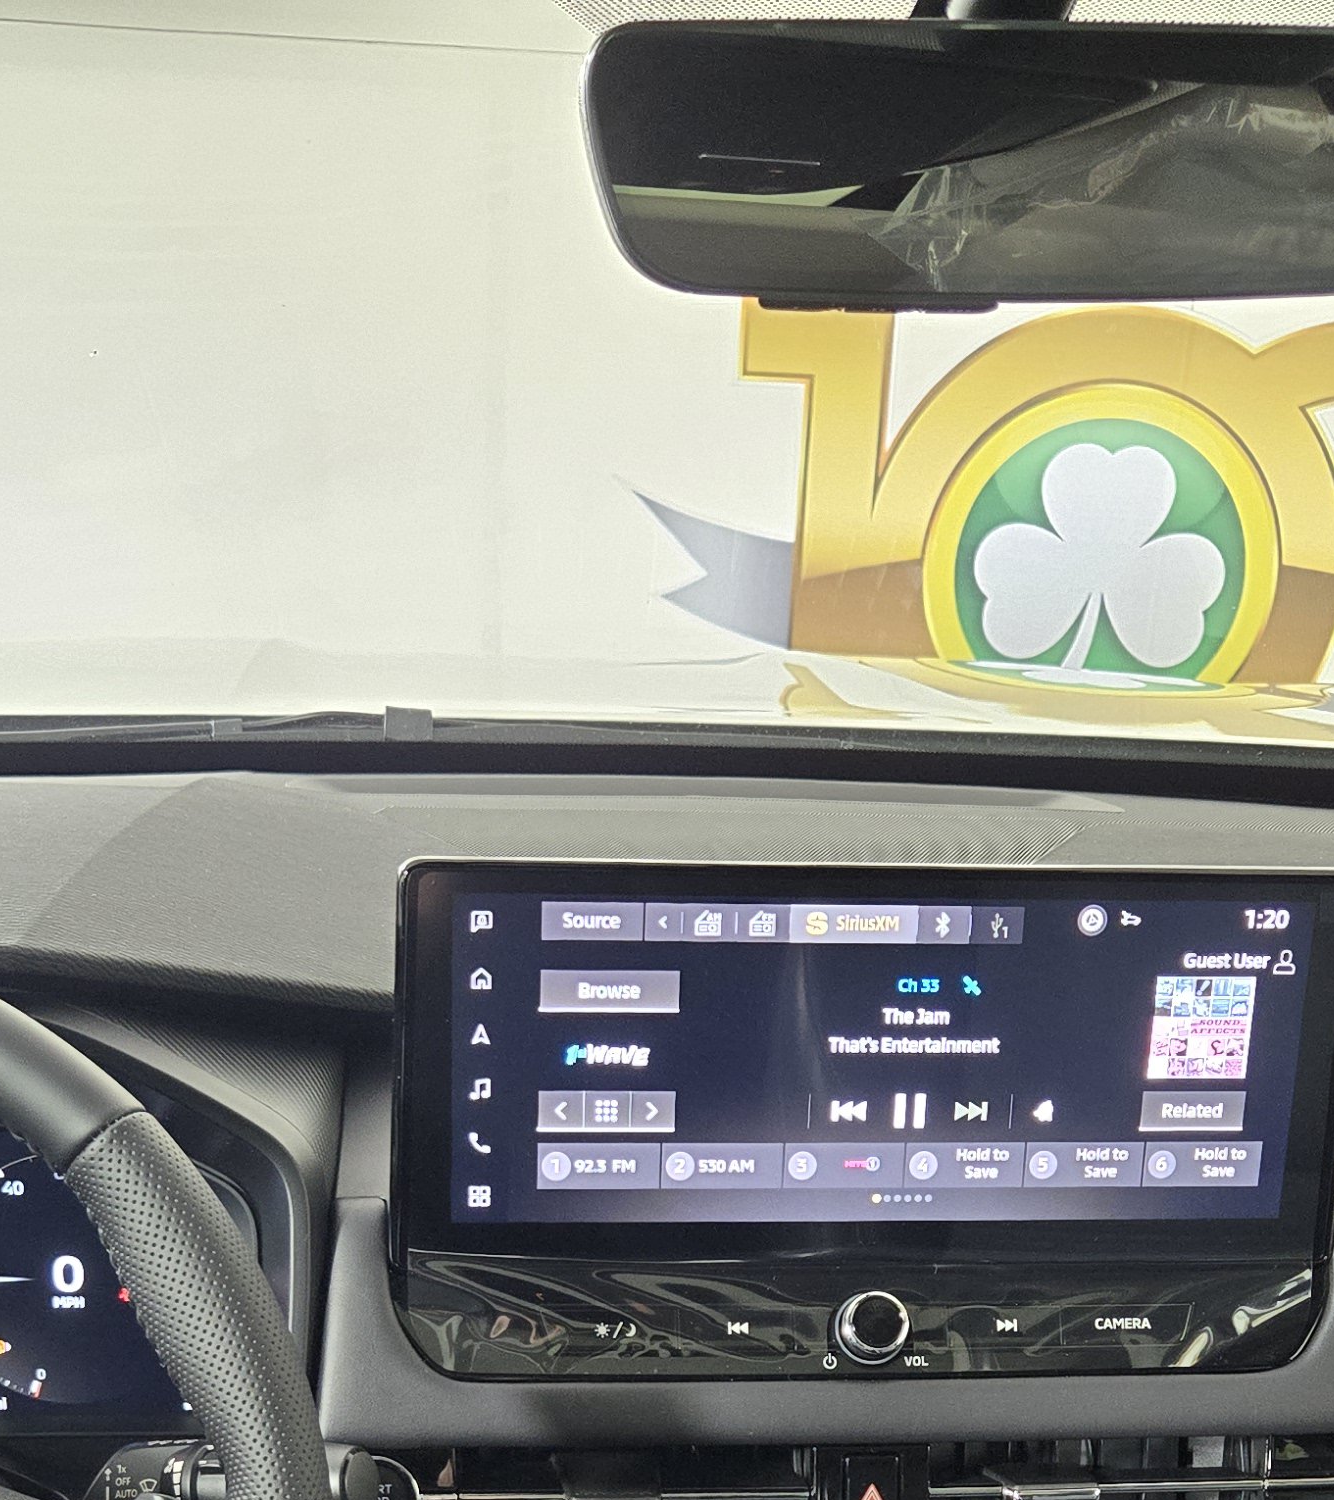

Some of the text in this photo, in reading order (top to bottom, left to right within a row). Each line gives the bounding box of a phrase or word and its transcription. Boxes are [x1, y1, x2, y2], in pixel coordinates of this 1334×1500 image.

[562, 912, 621, 930] Source
[836, 914, 900, 932] SiriusXM
[1244, 909, 1291, 929] 1:20
[1183, 952, 1271, 970] Guest User
[578, 982, 641, 1000] Browse
[897, 978, 940, 993] Ch 33
[882, 1007, 951, 1026] The Jam
[828, 1036, 1001, 1055] That's Entertainment
[1162, 1103, 1224, 1119] Related
[956, 1148, 1009, 1162] Hold to
[1076, 1148, 1129, 1162] Hold to
[1194, 1147, 1247, 1161] Hold to
[574, 1160, 607, 1174] 92.3
[612, 1160, 636, 1174] FM
[675, 1159, 755, 1174] 2 530 AM
[797, 1159, 808, 1173] 3
[917, 1158, 929, 1173] 4
[1038, 1158, 1048, 1172] 5
[1156, 1158, 1167, 1172] 6
[1202, 1165, 1234, 1178] Save
[965, 1166, 998, 1179] Save
[1084, 1166, 1117, 1179] Save
[0, 1180, 25, 1196] 40
[52, 1255, 85, 1293] 0
[52, 1295, 85, 1309] MPH
[1094, 1317, 1152, 1331] CAMERA
[904, 1355, 929, 1367] VOL
[116, 1464, 127, 1474] 1x
[115, 1477, 131, 1487] OFF
[115, 1489, 138, 1499] AUTO
